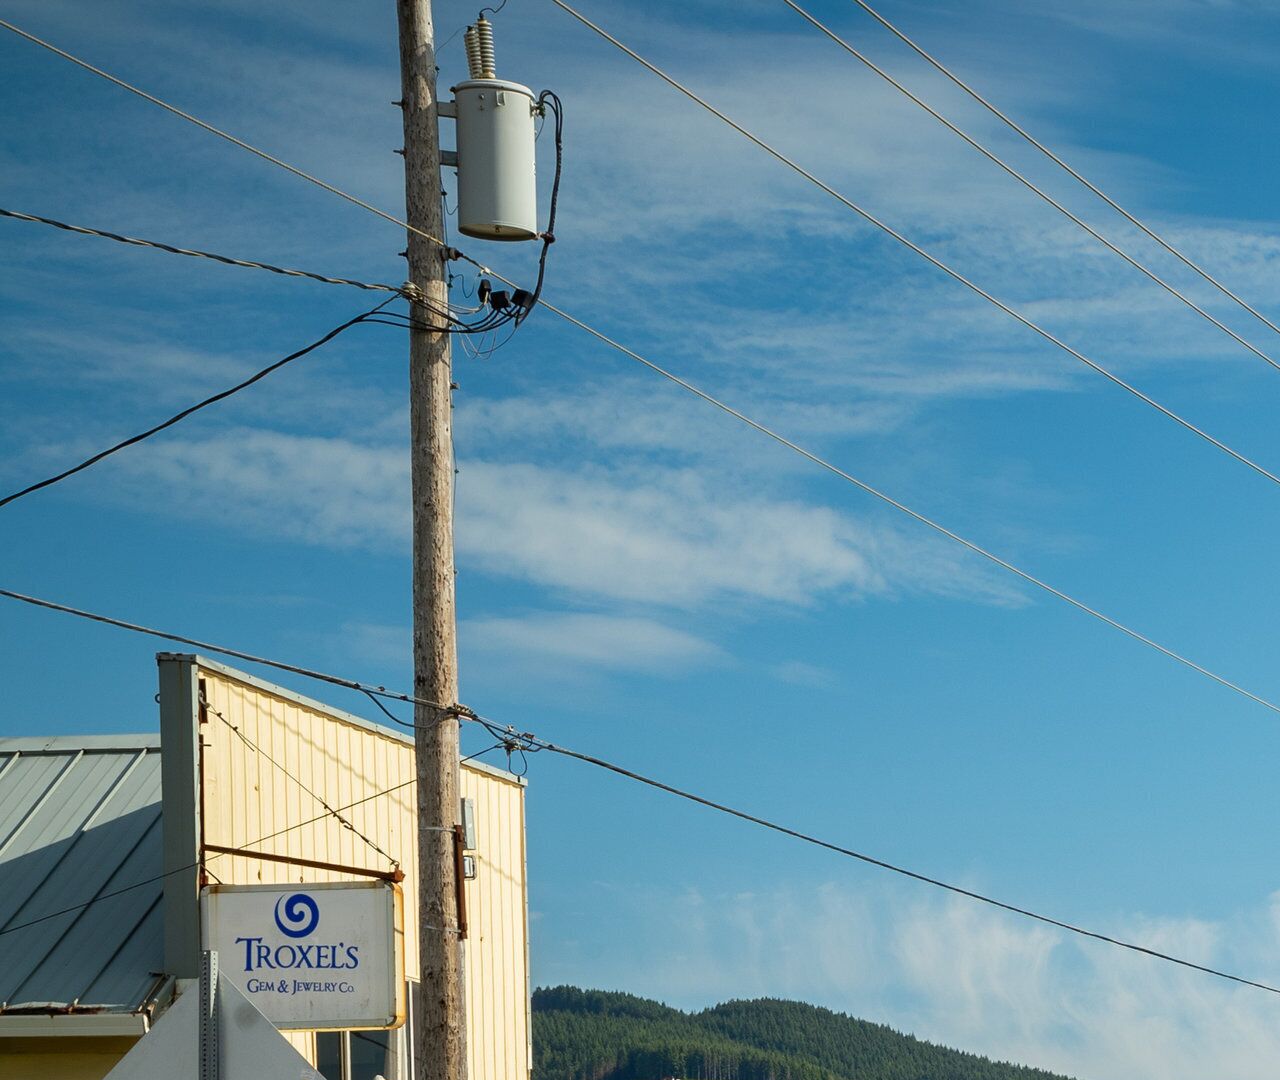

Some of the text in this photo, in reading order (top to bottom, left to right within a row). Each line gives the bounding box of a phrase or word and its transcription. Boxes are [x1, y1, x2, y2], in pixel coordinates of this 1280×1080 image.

[234, 937, 359, 972] TROXEL'S
[277, 979, 289, 993] &
[291, 979, 338, 995] JEWELRY
